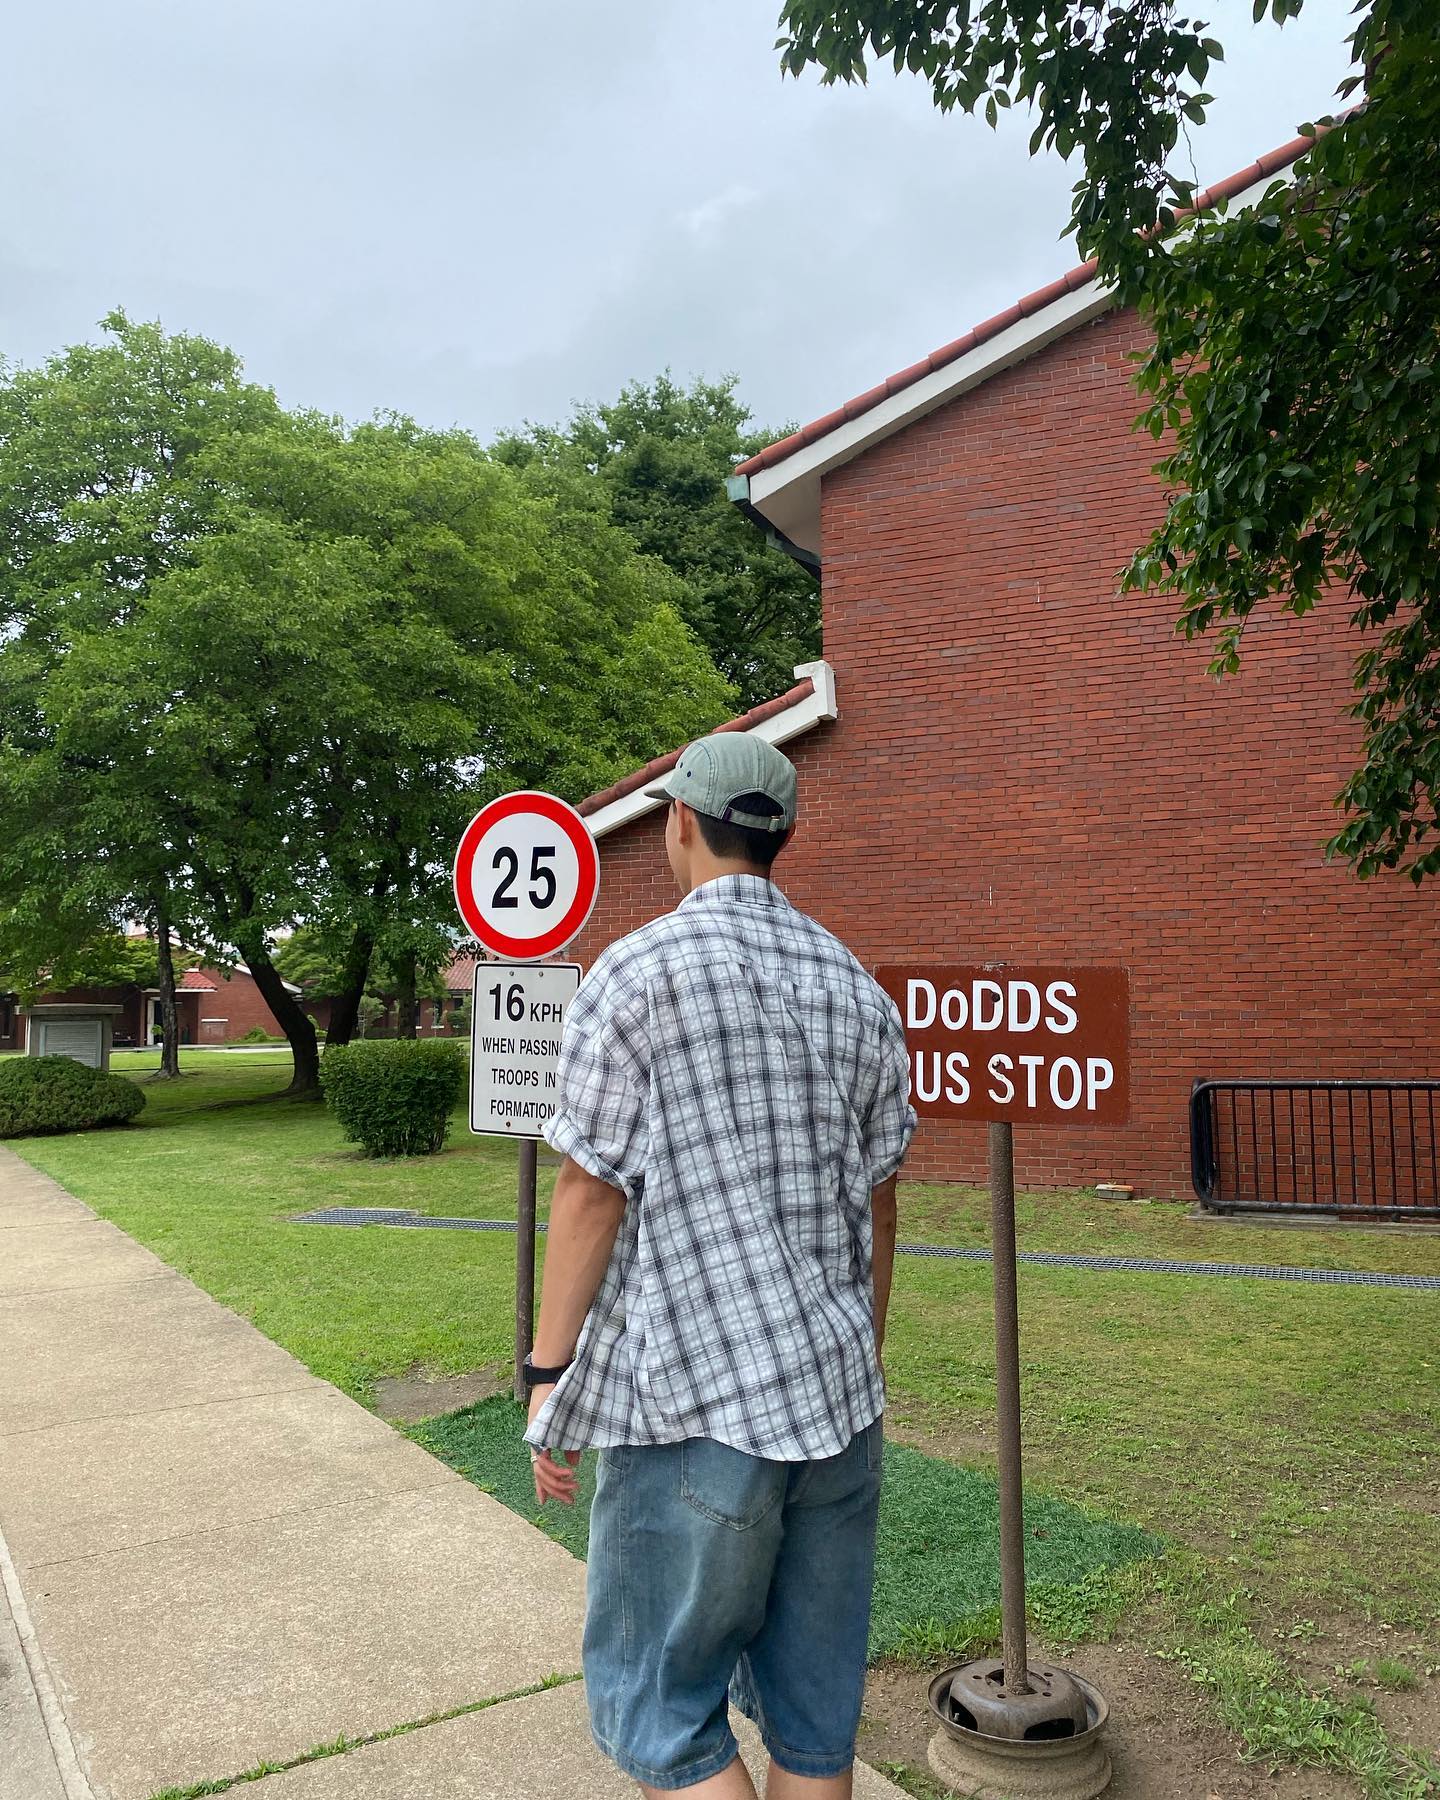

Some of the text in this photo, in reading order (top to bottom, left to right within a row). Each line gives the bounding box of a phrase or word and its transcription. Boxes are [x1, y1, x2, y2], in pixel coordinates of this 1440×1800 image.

[492, 846, 556, 909] 25
[489, 983, 562, 1023] 16 KPH
[907, 978, 1077, 1034] DoDDS
[482, 1037, 563, 1056] WHEN PASSIN
[492, 1068, 556, 1088] TROOPS IN
[907, 1050, 1114, 1110] US STOP
[490, 1099, 555, 1119] FORMATION
